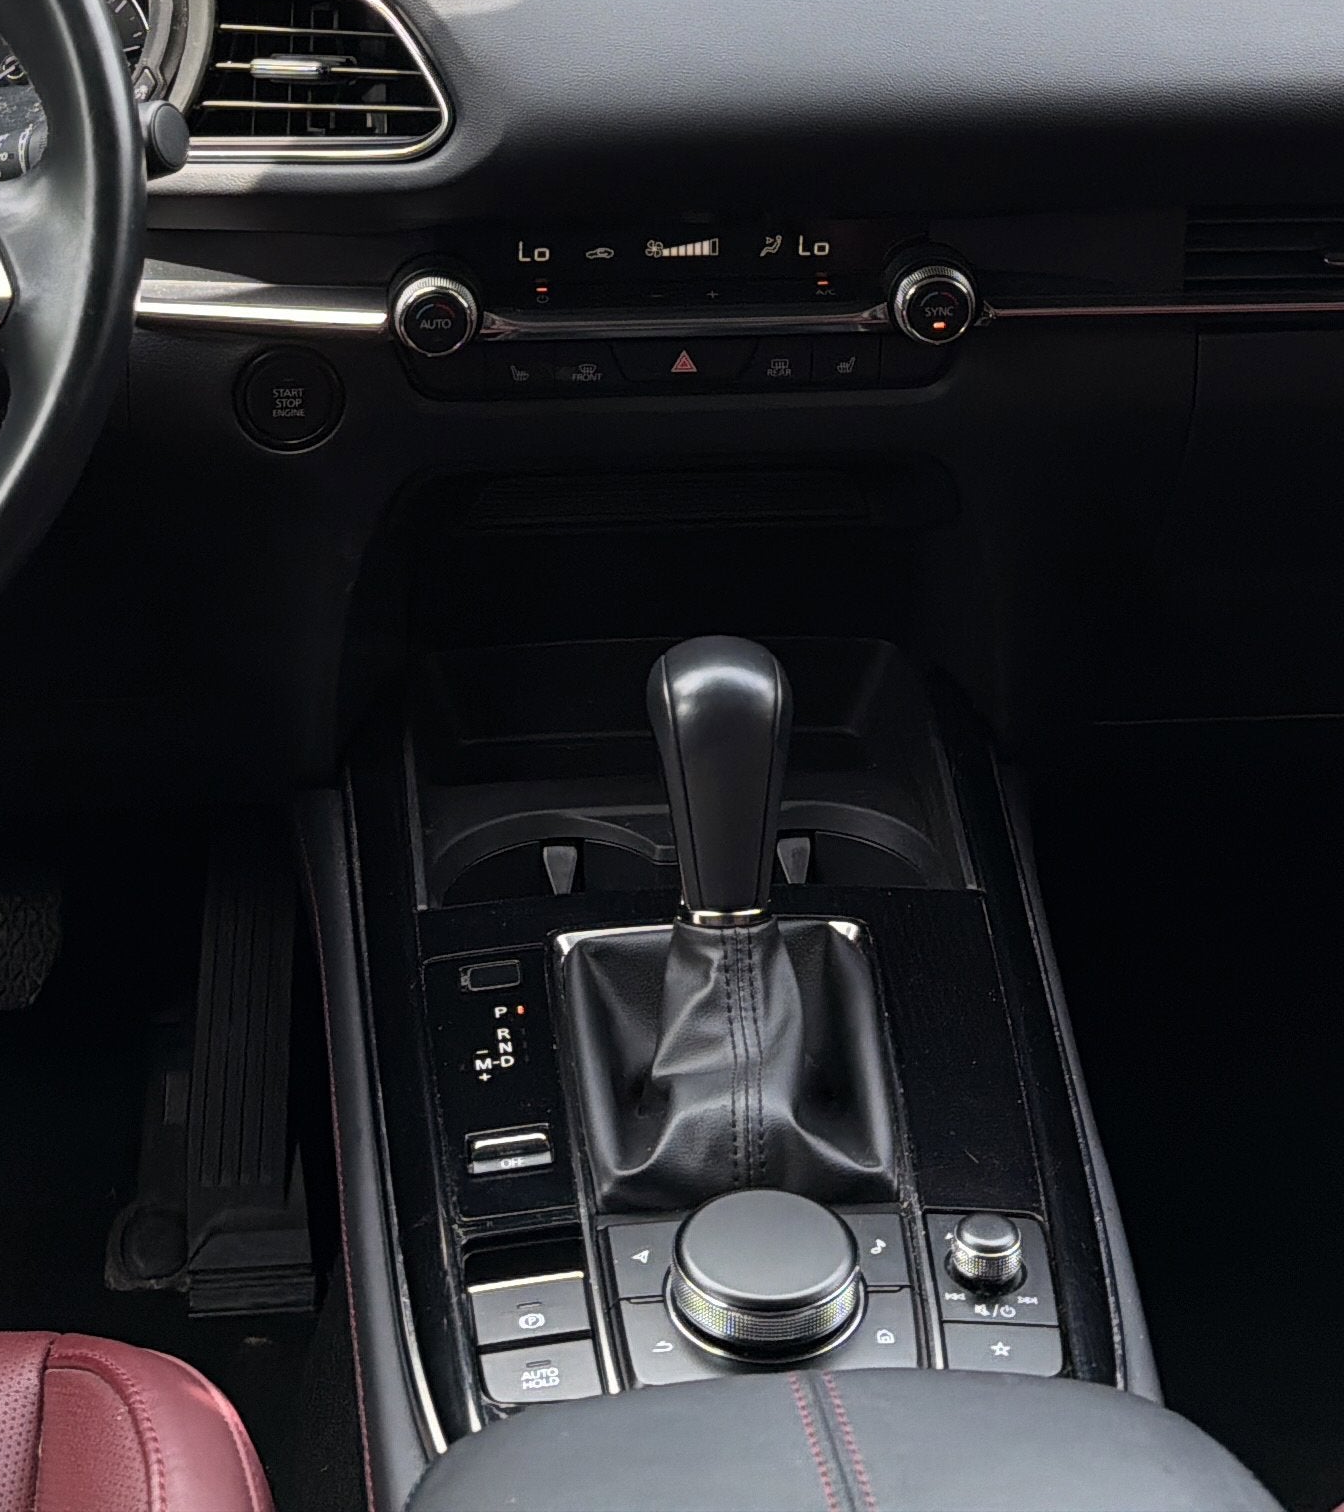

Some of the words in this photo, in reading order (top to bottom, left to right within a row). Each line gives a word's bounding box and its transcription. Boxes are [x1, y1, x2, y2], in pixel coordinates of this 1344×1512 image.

[518, 241, 550, 262] Lo
[799, 235, 830, 256] Lo
[924, 306, 954, 318] SYNC
[419, 318, 452, 329] AUTO
[572, 373, 602, 382] FRONT
[272, 389, 304, 398] START
[275, 398, 302, 408] STOP
[272, 408, 305, 417] ENGINE
[494, 1006, 508, 1018] P
[497, 1028, 511, 1040] R
[498, 1042, 513, 1054] N
[500, 1157, 525, 1168] OFF
[521, 1367, 559, 1381] AUTO
[522, 1376, 560, 1390] HOLD
